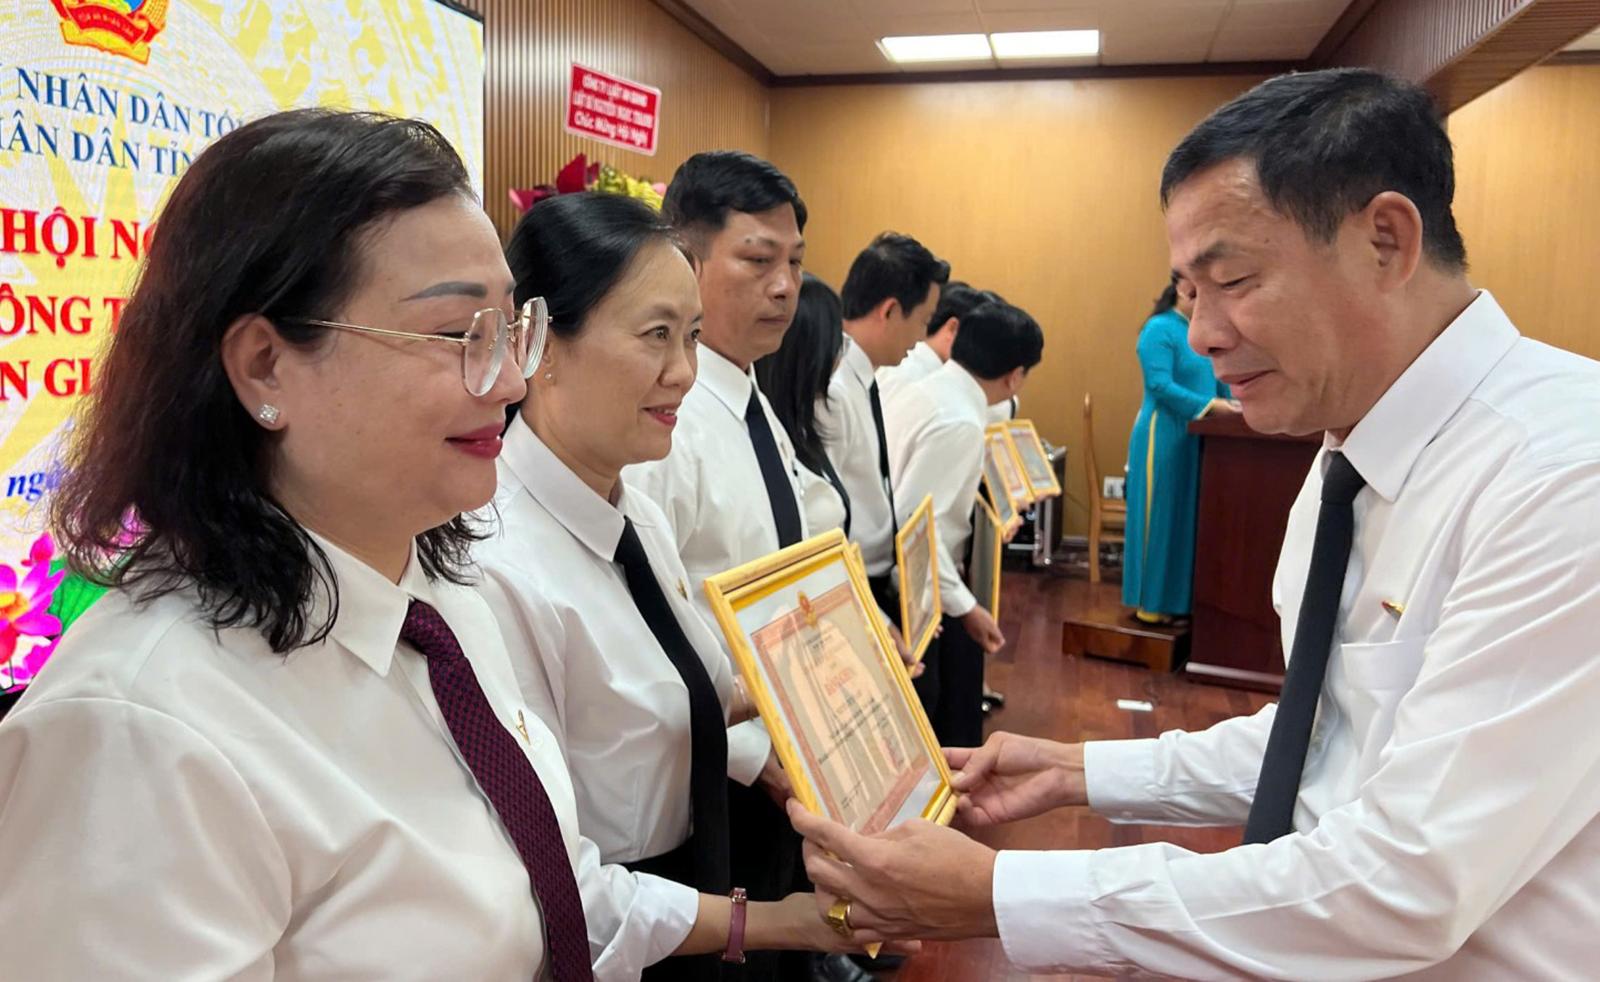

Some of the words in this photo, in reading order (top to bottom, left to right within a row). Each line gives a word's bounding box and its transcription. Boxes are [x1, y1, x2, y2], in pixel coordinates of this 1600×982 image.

[17, 67, 118, 120] NHÂN
[130, 91, 191, 135] DÂN
[0, 109, 58, 158] ÂN
[72, 126, 140, 171] DÂN
[0, 206, 97, 268] HỘI
